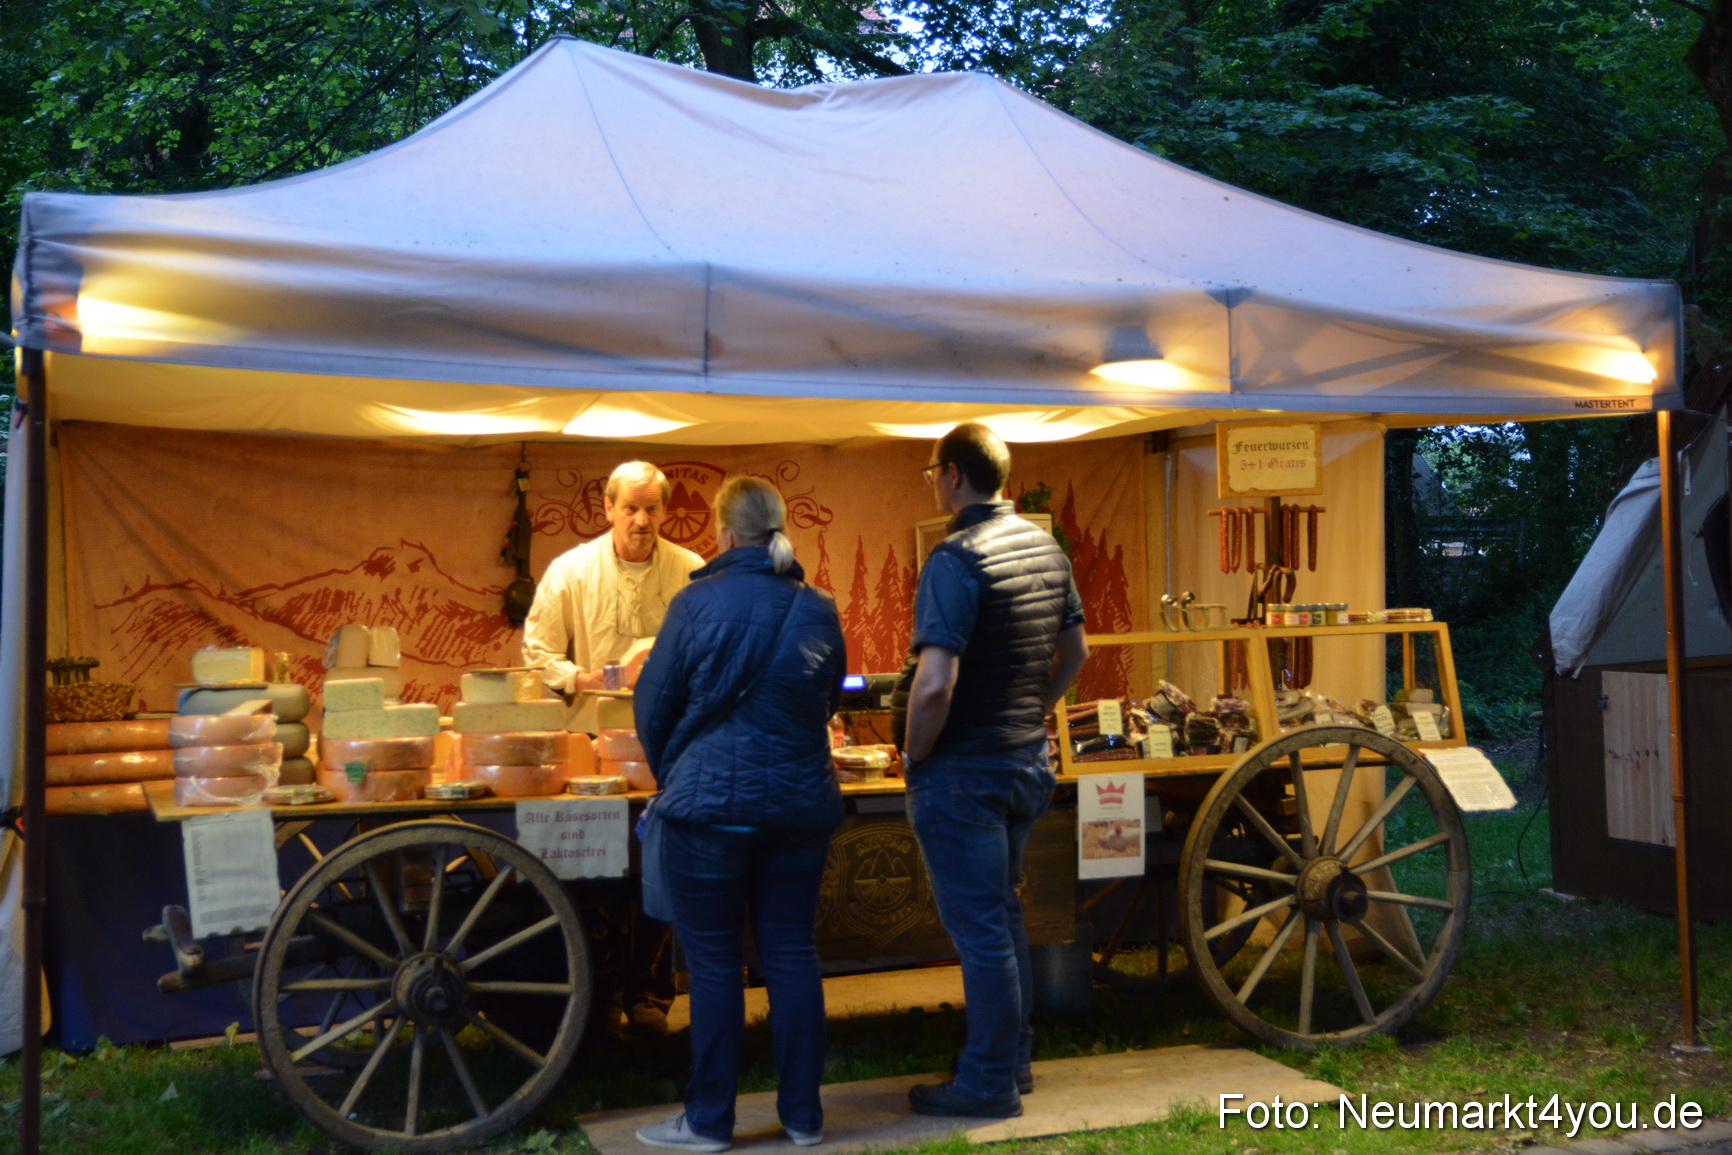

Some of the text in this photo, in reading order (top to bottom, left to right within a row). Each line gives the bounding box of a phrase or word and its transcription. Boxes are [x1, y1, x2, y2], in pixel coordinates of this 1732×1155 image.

[1574, 398, 1636, 409] MASTERTENT
[1268, 457, 1307, 469] Gratis
[664, 467, 709, 486] NITAS
[524, 809, 620, 824] Alle Käsesorten
[560, 829, 585, 840] sind
[540, 845, 607, 859] Laktosefrei
